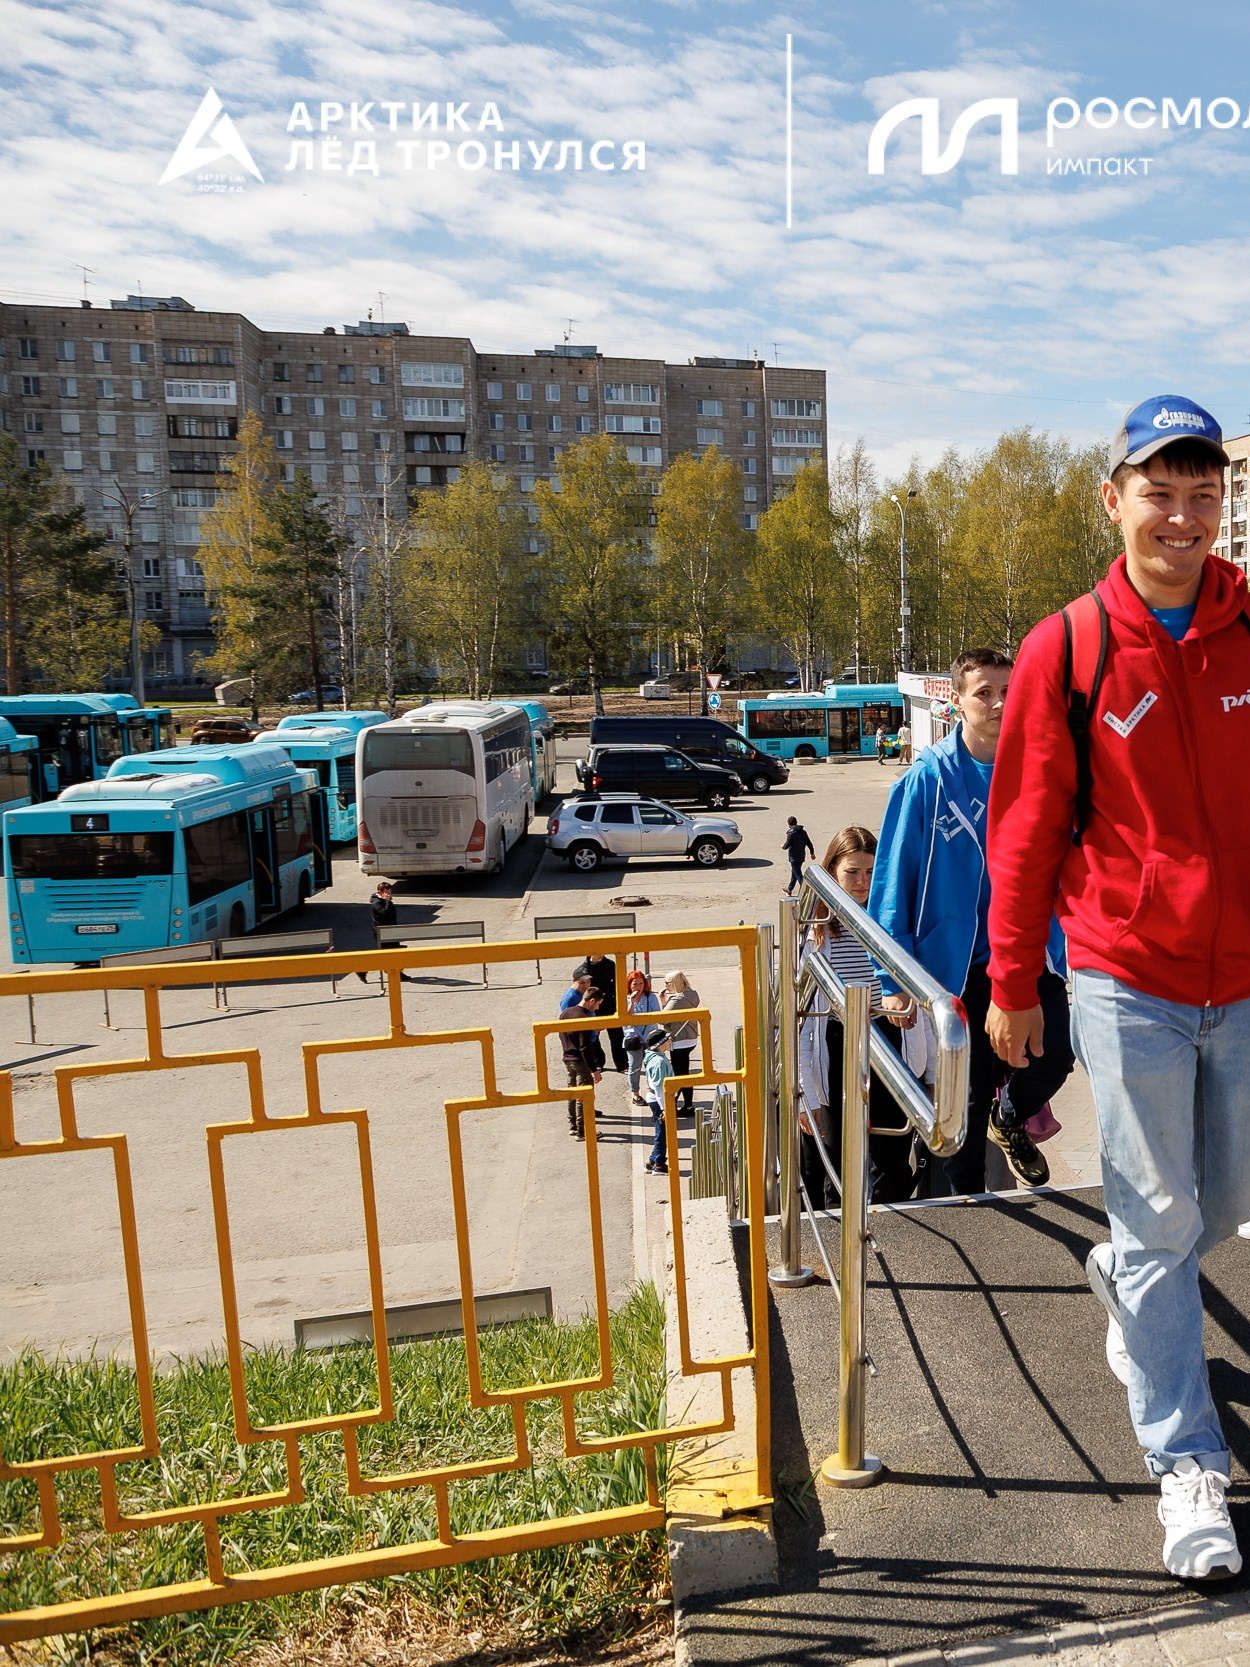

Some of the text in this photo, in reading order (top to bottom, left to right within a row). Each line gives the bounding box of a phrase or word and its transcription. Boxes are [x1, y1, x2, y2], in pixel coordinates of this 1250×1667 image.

[1107, 715, 1127, 734] ЧИСТАЯ
[1126, 704, 1146, 728] АРКТИКА
[86, 817, 94, 829] 4
